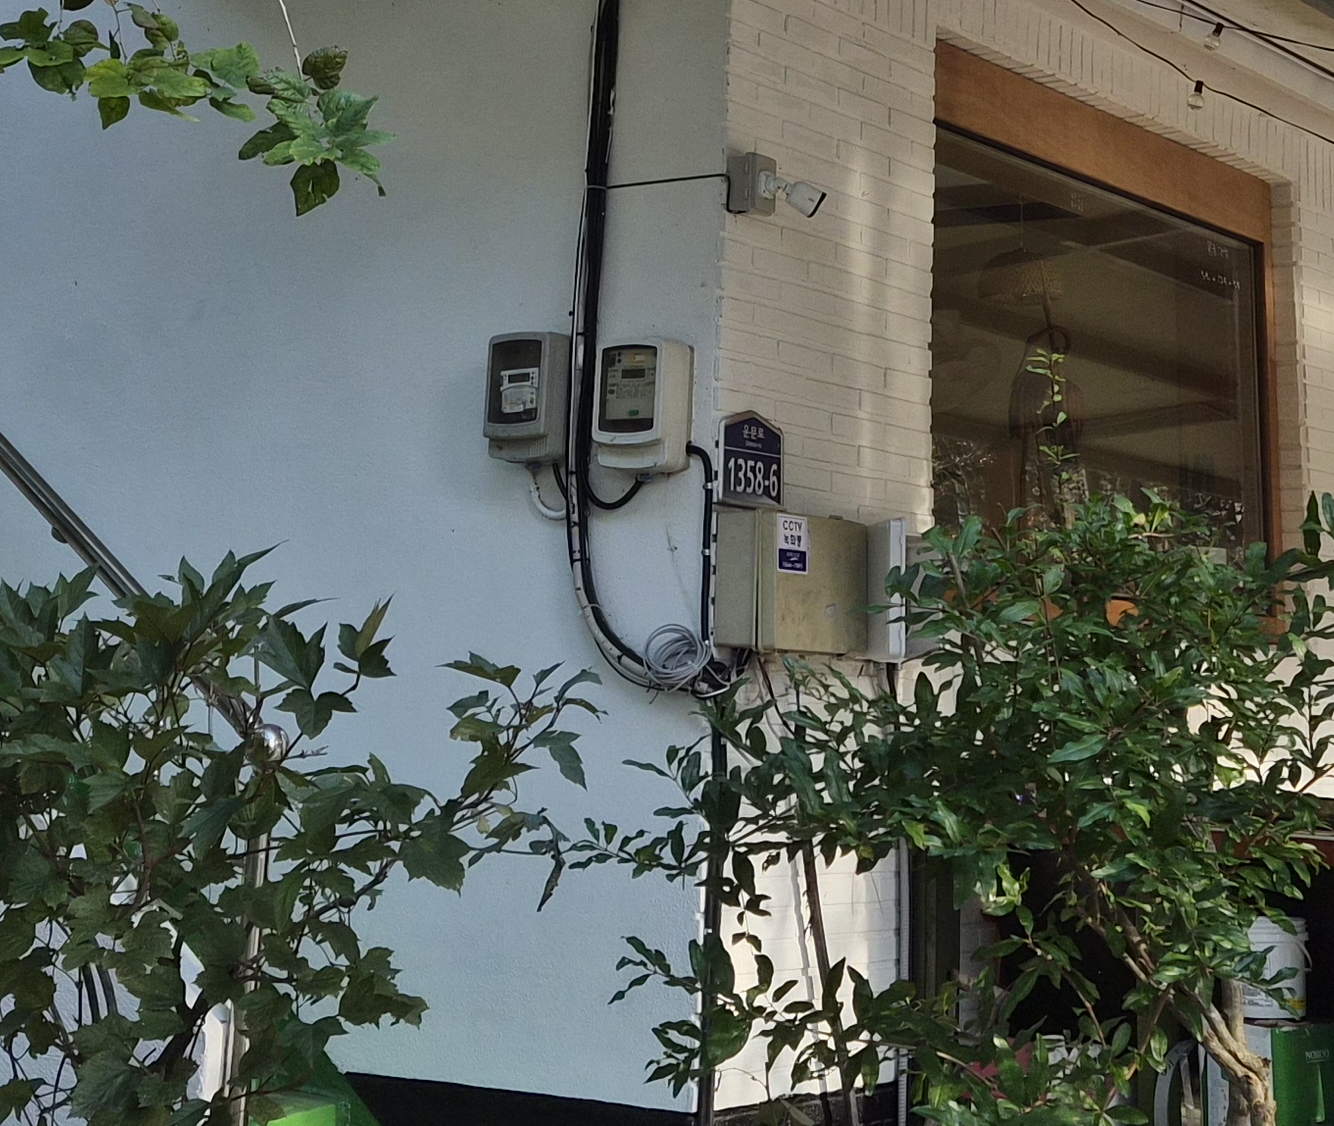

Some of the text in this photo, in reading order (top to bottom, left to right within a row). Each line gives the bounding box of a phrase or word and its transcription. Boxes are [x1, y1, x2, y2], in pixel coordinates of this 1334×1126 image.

[742, 424, 765, 440] 운문로
[727, 457, 779, 497] 1358-6
[782, 519, 803, 532] CCTV
